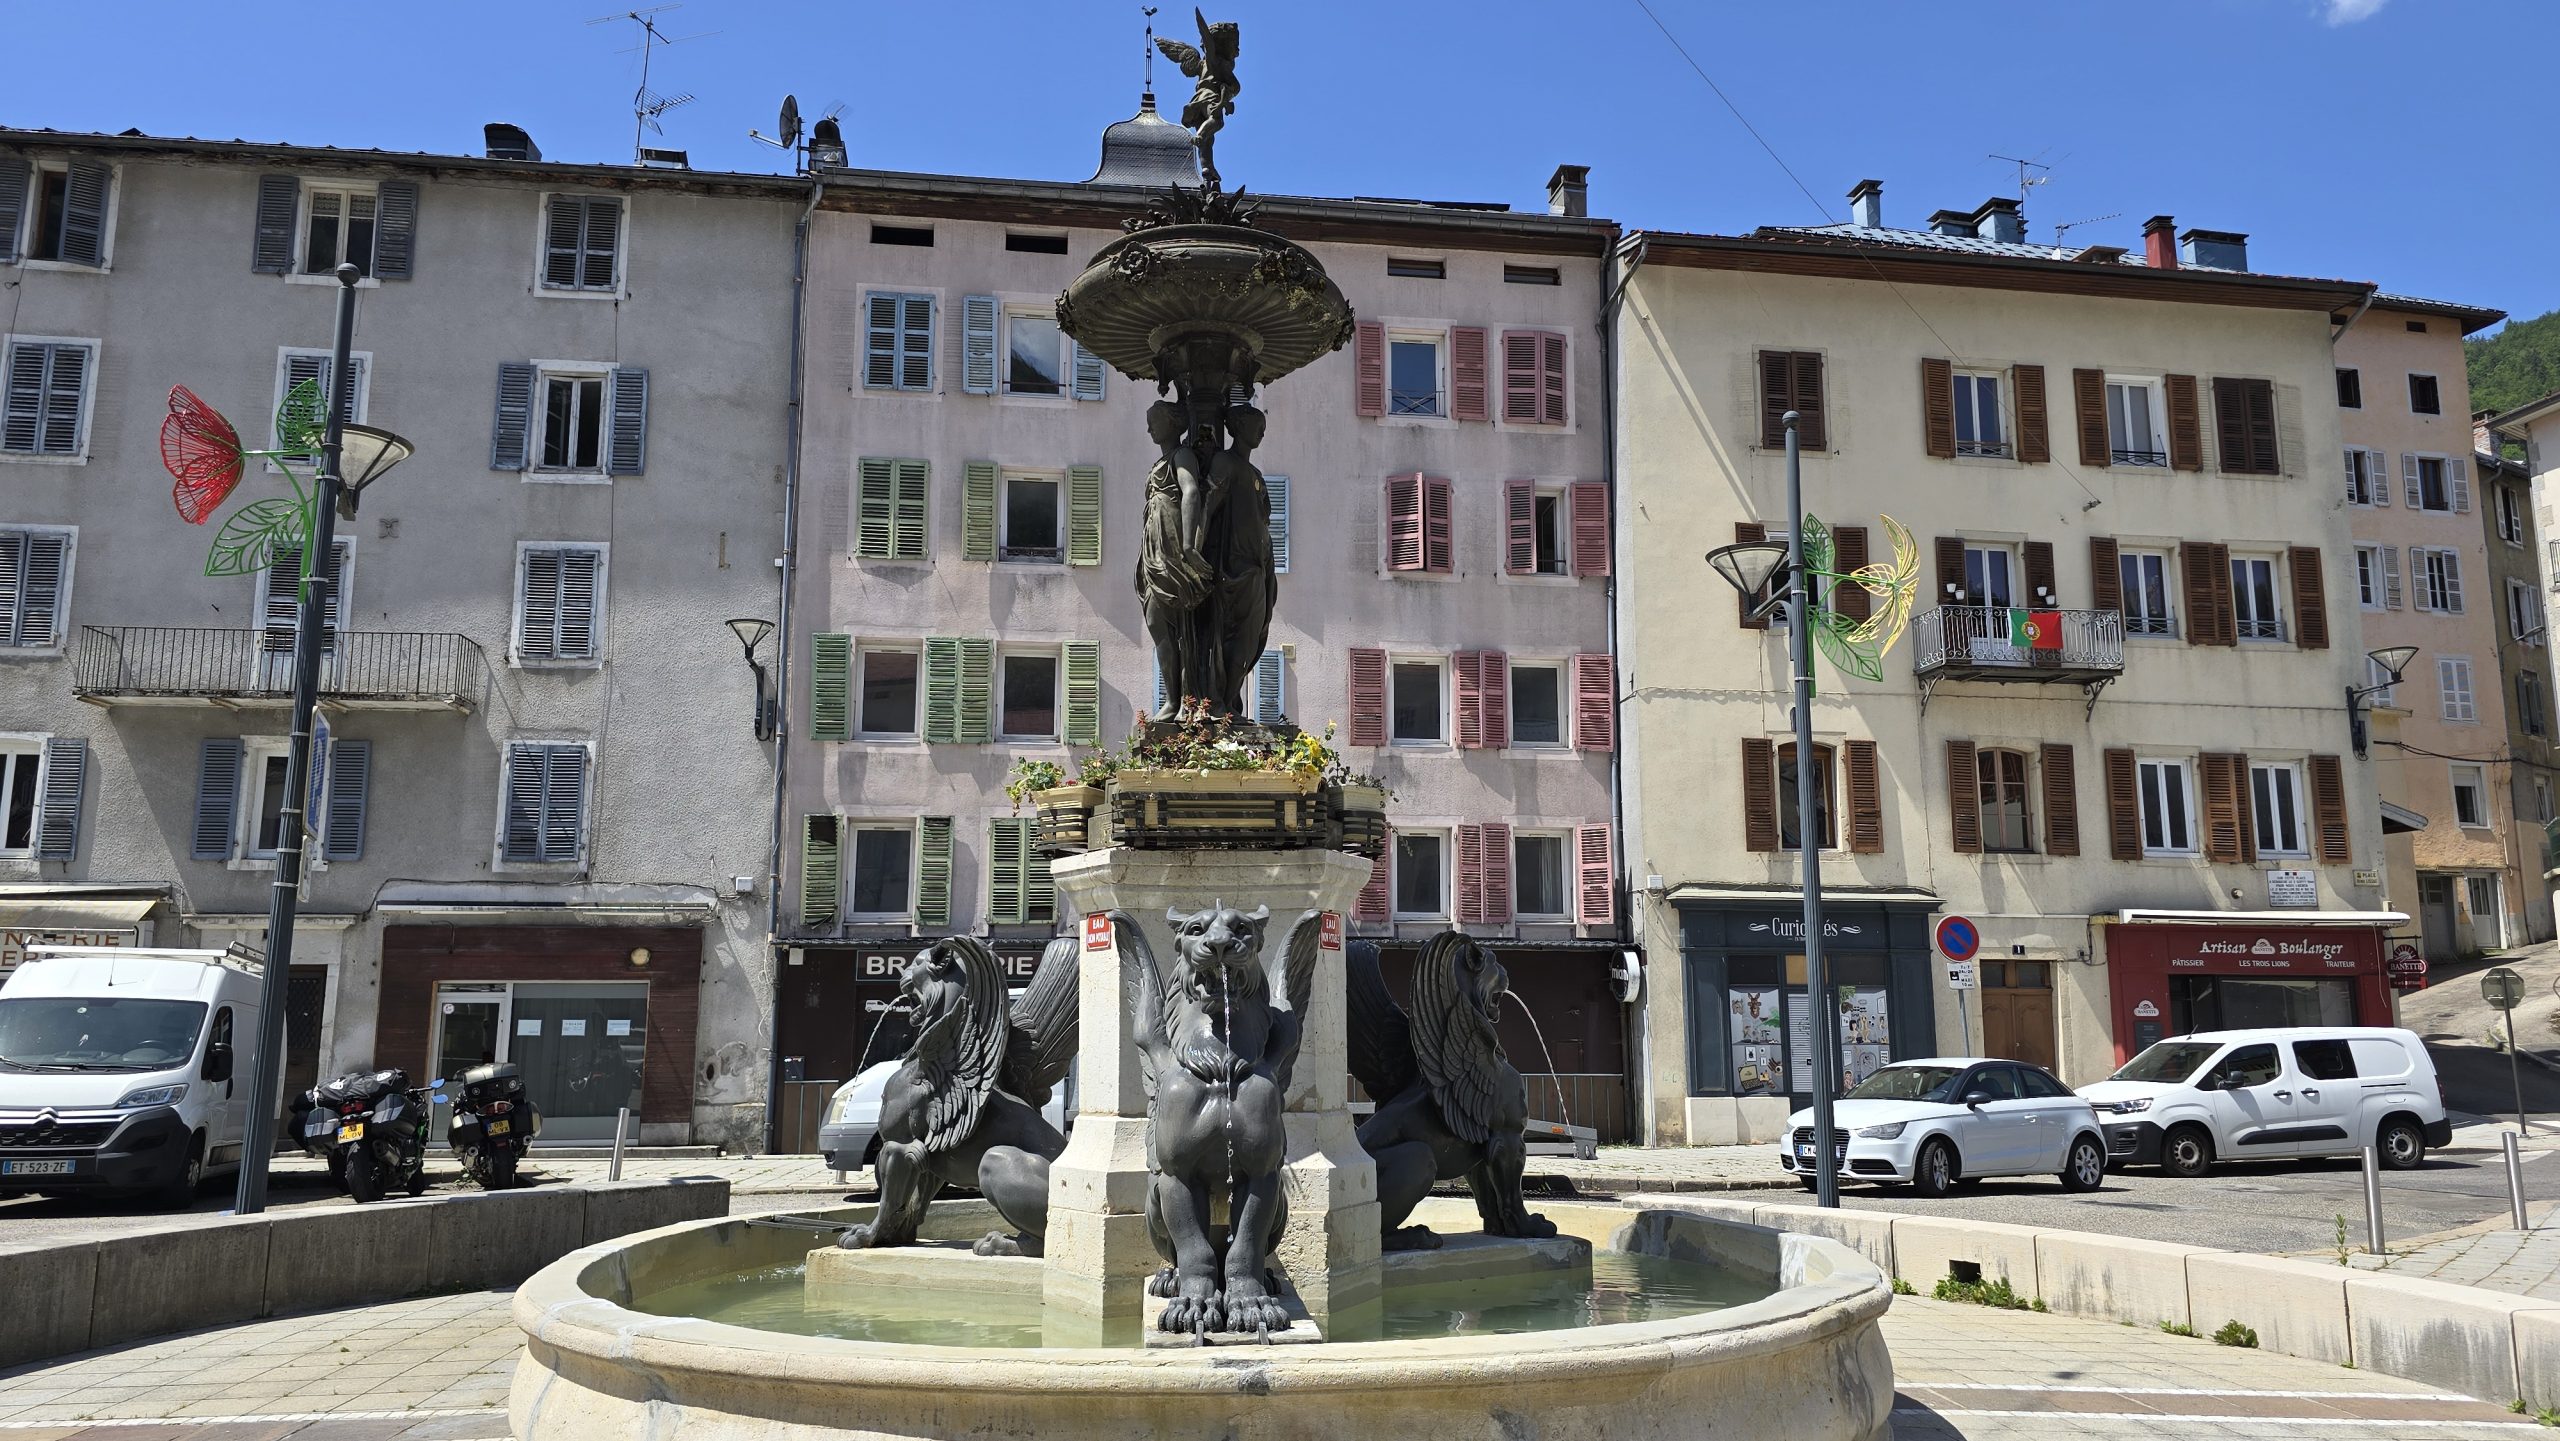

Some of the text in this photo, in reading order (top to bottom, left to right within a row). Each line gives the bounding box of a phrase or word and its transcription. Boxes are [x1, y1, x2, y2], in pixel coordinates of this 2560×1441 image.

[1092, 918, 1105, 929] EAU
[1326, 919, 1336, 929] EAU
[1772, 917, 1839, 936] Curioés
[2200, 941, 2248, 954] Artisan
[2279, 939, 2343, 960] Boulanger
[2172, 958, 2204, 967] PÂTISSIER
[2390, 963, 2423, 971] BANETTE
